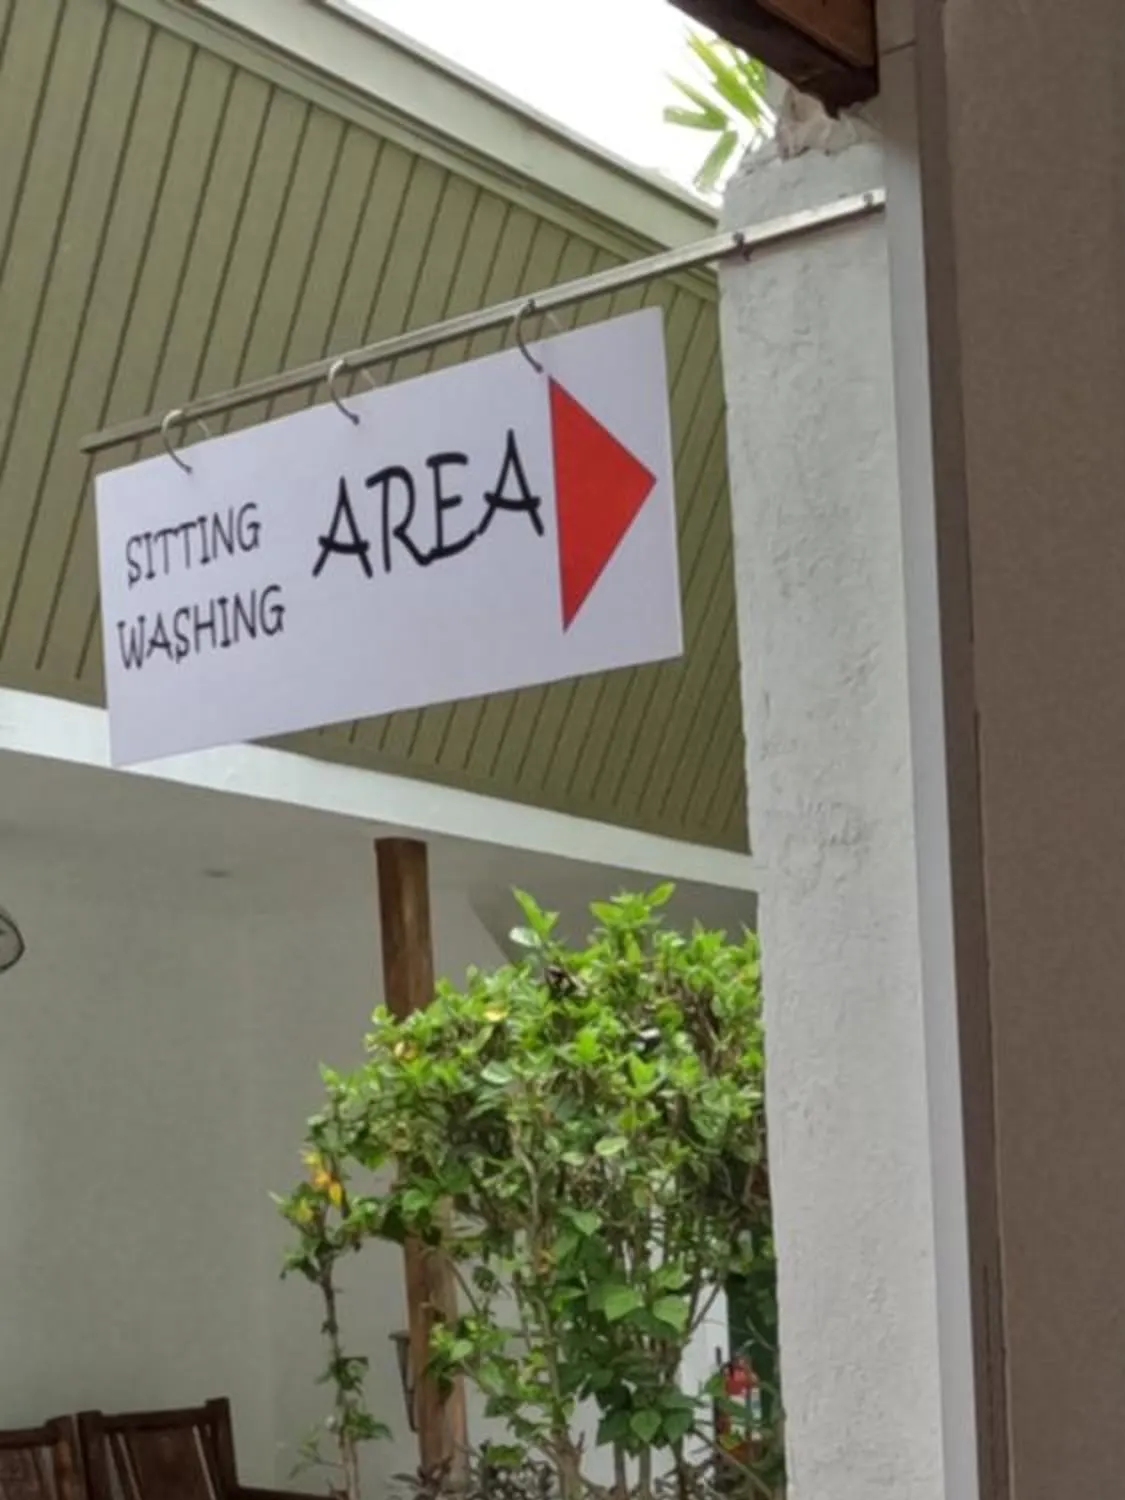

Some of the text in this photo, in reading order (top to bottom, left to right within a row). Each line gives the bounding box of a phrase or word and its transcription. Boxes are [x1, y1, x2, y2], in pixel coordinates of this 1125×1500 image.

[124, 502, 261, 589] SITTING
[312, 429, 545, 580] AREA
[117, 584, 286, 671] WASHING
